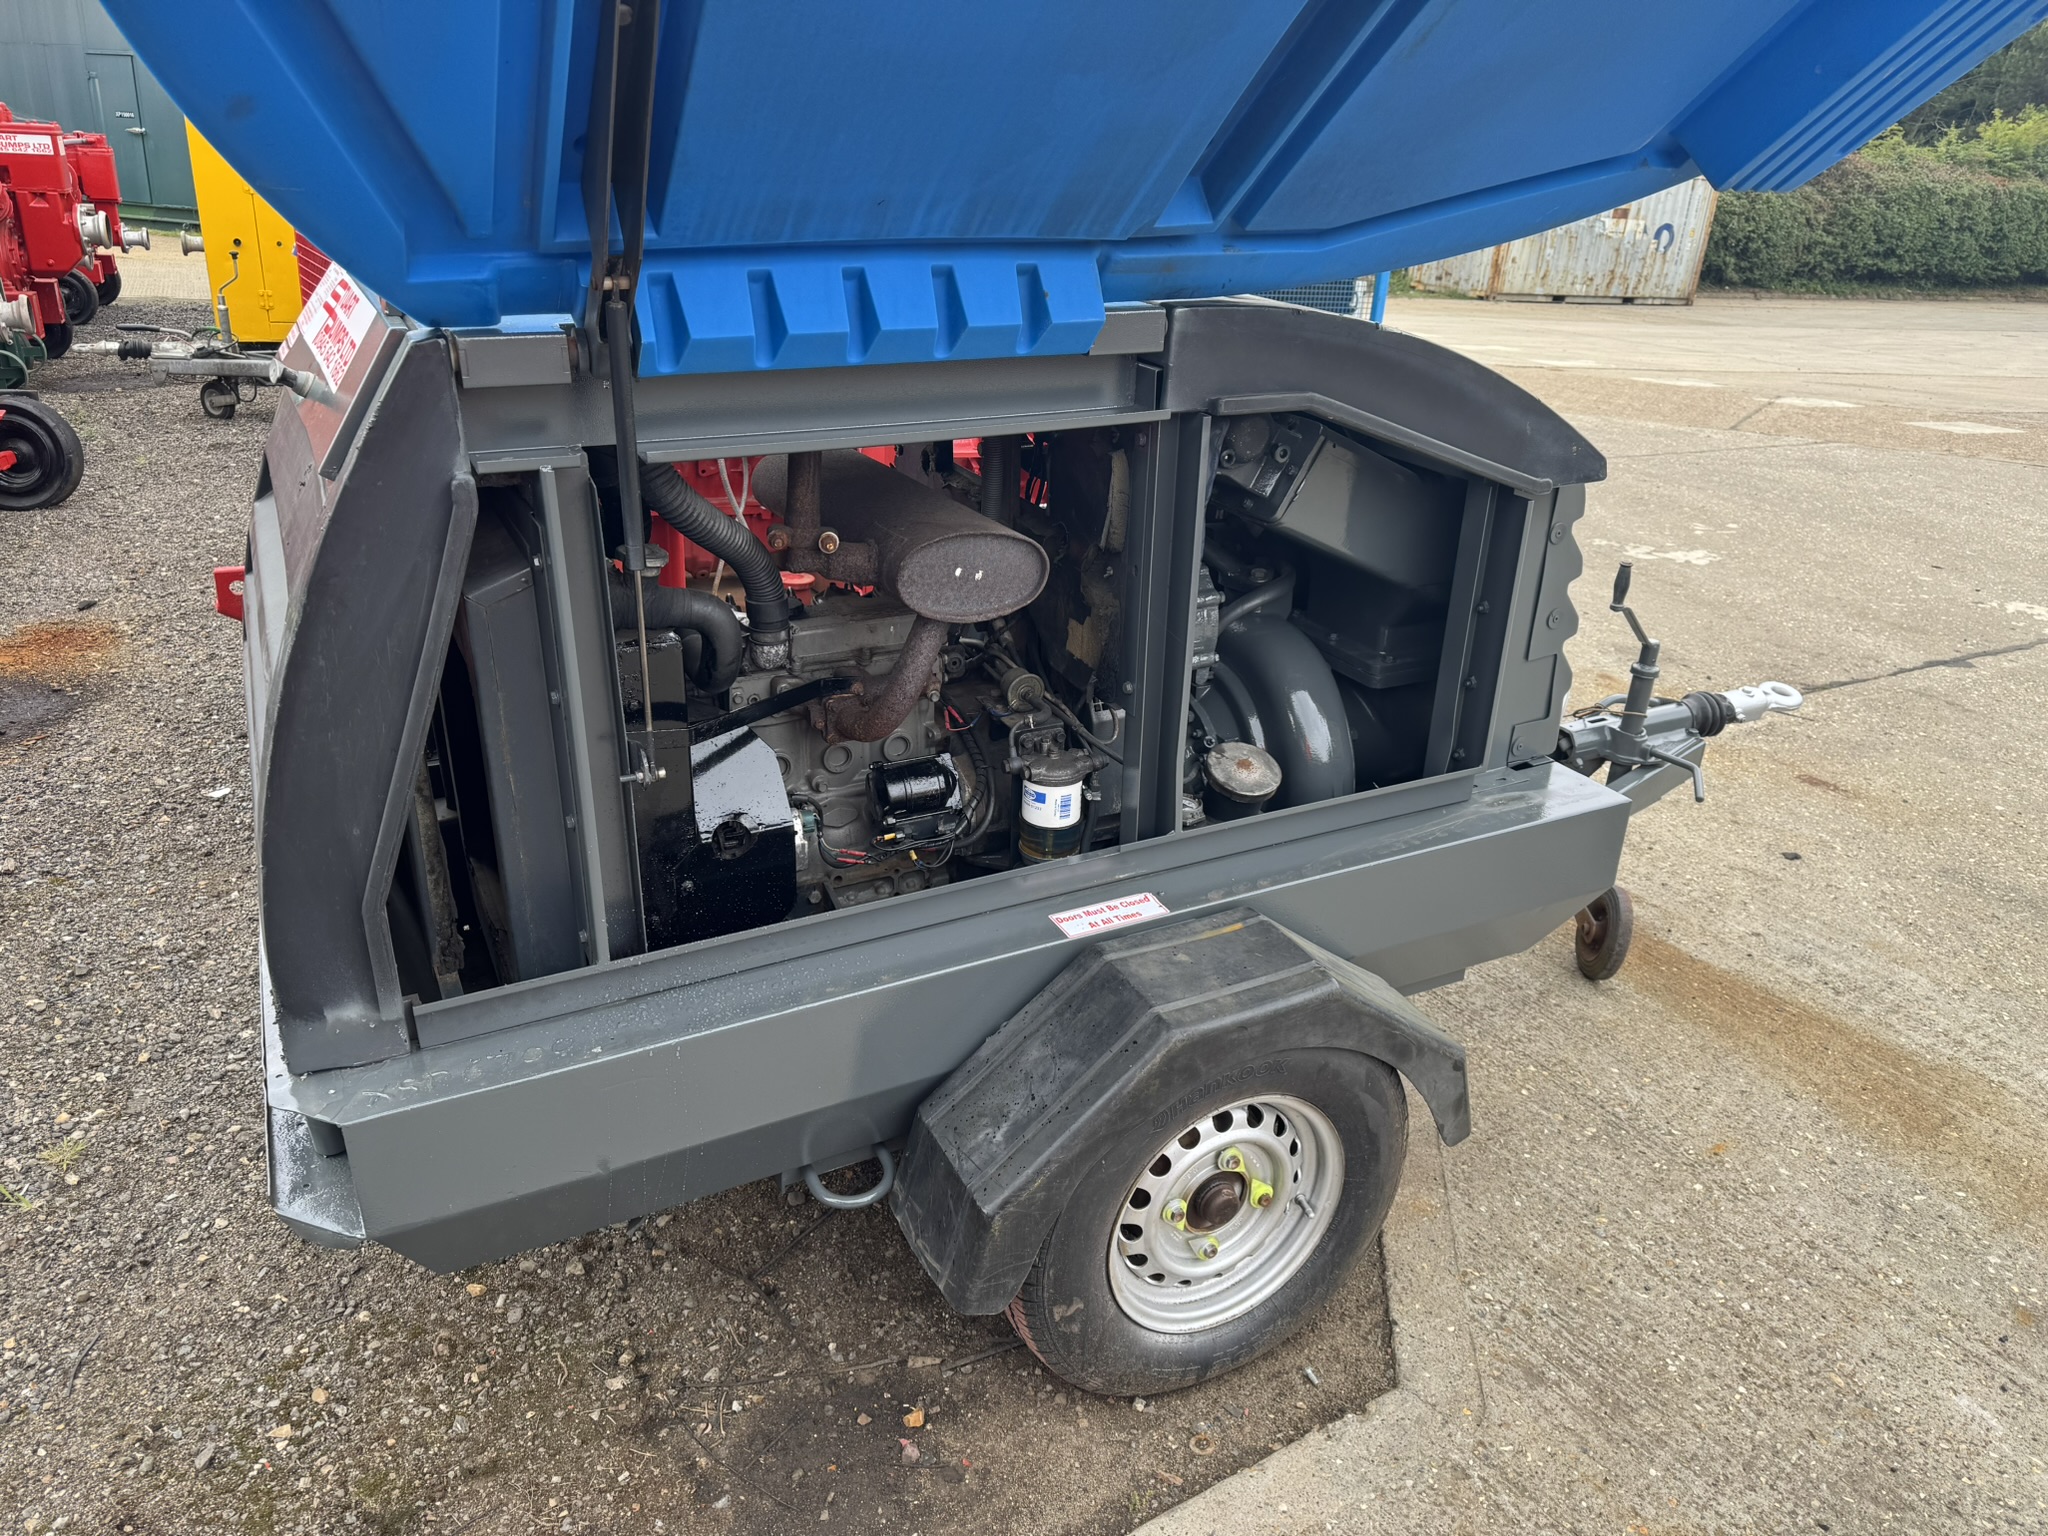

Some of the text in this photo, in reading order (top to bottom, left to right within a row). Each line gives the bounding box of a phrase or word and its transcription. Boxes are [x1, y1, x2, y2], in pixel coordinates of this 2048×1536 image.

[312, 301, 350, 354] PUMPS
[340, 335, 357, 367] LTD
[1055, 895, 1150, 924] Doors Must Be Closed
[1088, 911, 1142, 929] At All Times
